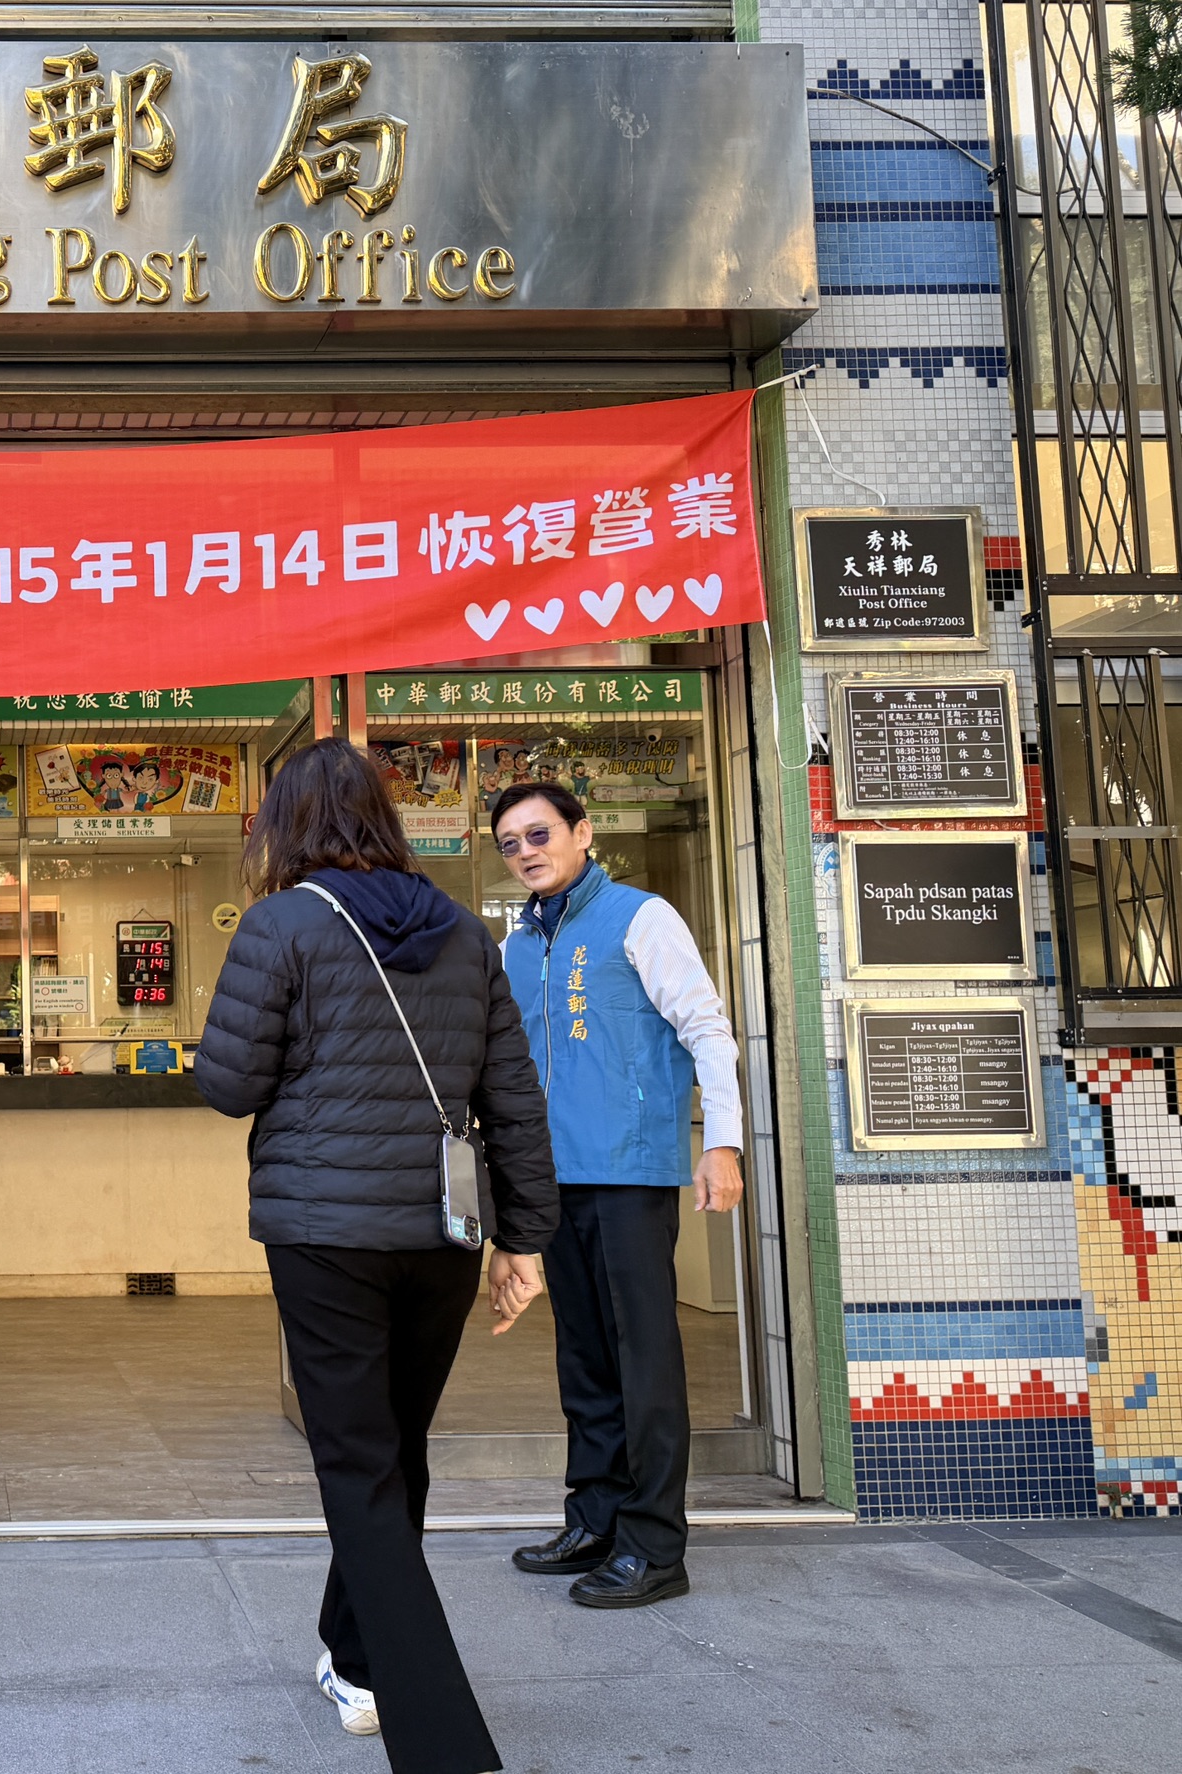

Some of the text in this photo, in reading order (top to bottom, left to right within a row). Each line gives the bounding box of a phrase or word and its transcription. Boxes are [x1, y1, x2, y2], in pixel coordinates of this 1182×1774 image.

[45, 226, 210, 305] Post
[253, 222, 516, 303] Office
[866, 529, 913, 552] 秀林
[843, 554, 938, 577] 天祥郵局
[838, 584, 946, 597] Xiulin Tianxiang
[859, 598, 928, 609] Post Office
[873, 618, 892, 629] Zip
[376, 679, 682, 706] 中華郵政股份有限公司
[872, 690, 978, 703] 營業時間
[14, 686, 194, 711] 祝您旅途愉快
[894, 729, 939, 737] 08:30~12:00
[957, 729, 991, 742] 休息
[895, 747, 940, 755] 08:30~12:00
[958, 747, 993, 759] 休息
[897, 764, 942, 773] 08:30~12:00
[959, 765, 994, 777] 休息
[898, 772, 943, 780] 12:40~15:30
[73, 818, 155, 829] 受理儲匯業務
[864, 883, 1014, 903] Sapah pdsan patas
[882, 904, 998, 924] Tpdu Skangki
[141, 942, 162, 954] 115
[150, 958, 163, 969] 14
[134, 988, 166, 1001] 8:36
[567, 945, 588, 1041] 花蓮郵局
[910, 1021, 975, 1032] Jiyax qpahan
[911, 1056, 957, 1064] 08:30~12:00
[979, 1060, 1007, 1068] msangay
[912, 1065, 957, 1073] 12:40~16:10
[914, 1093, 960, 1101] 08:30~12:00
[982, 1098, 1011, 1106] msangay
[915, 1102, 960, 1111] 12:40~15:30
